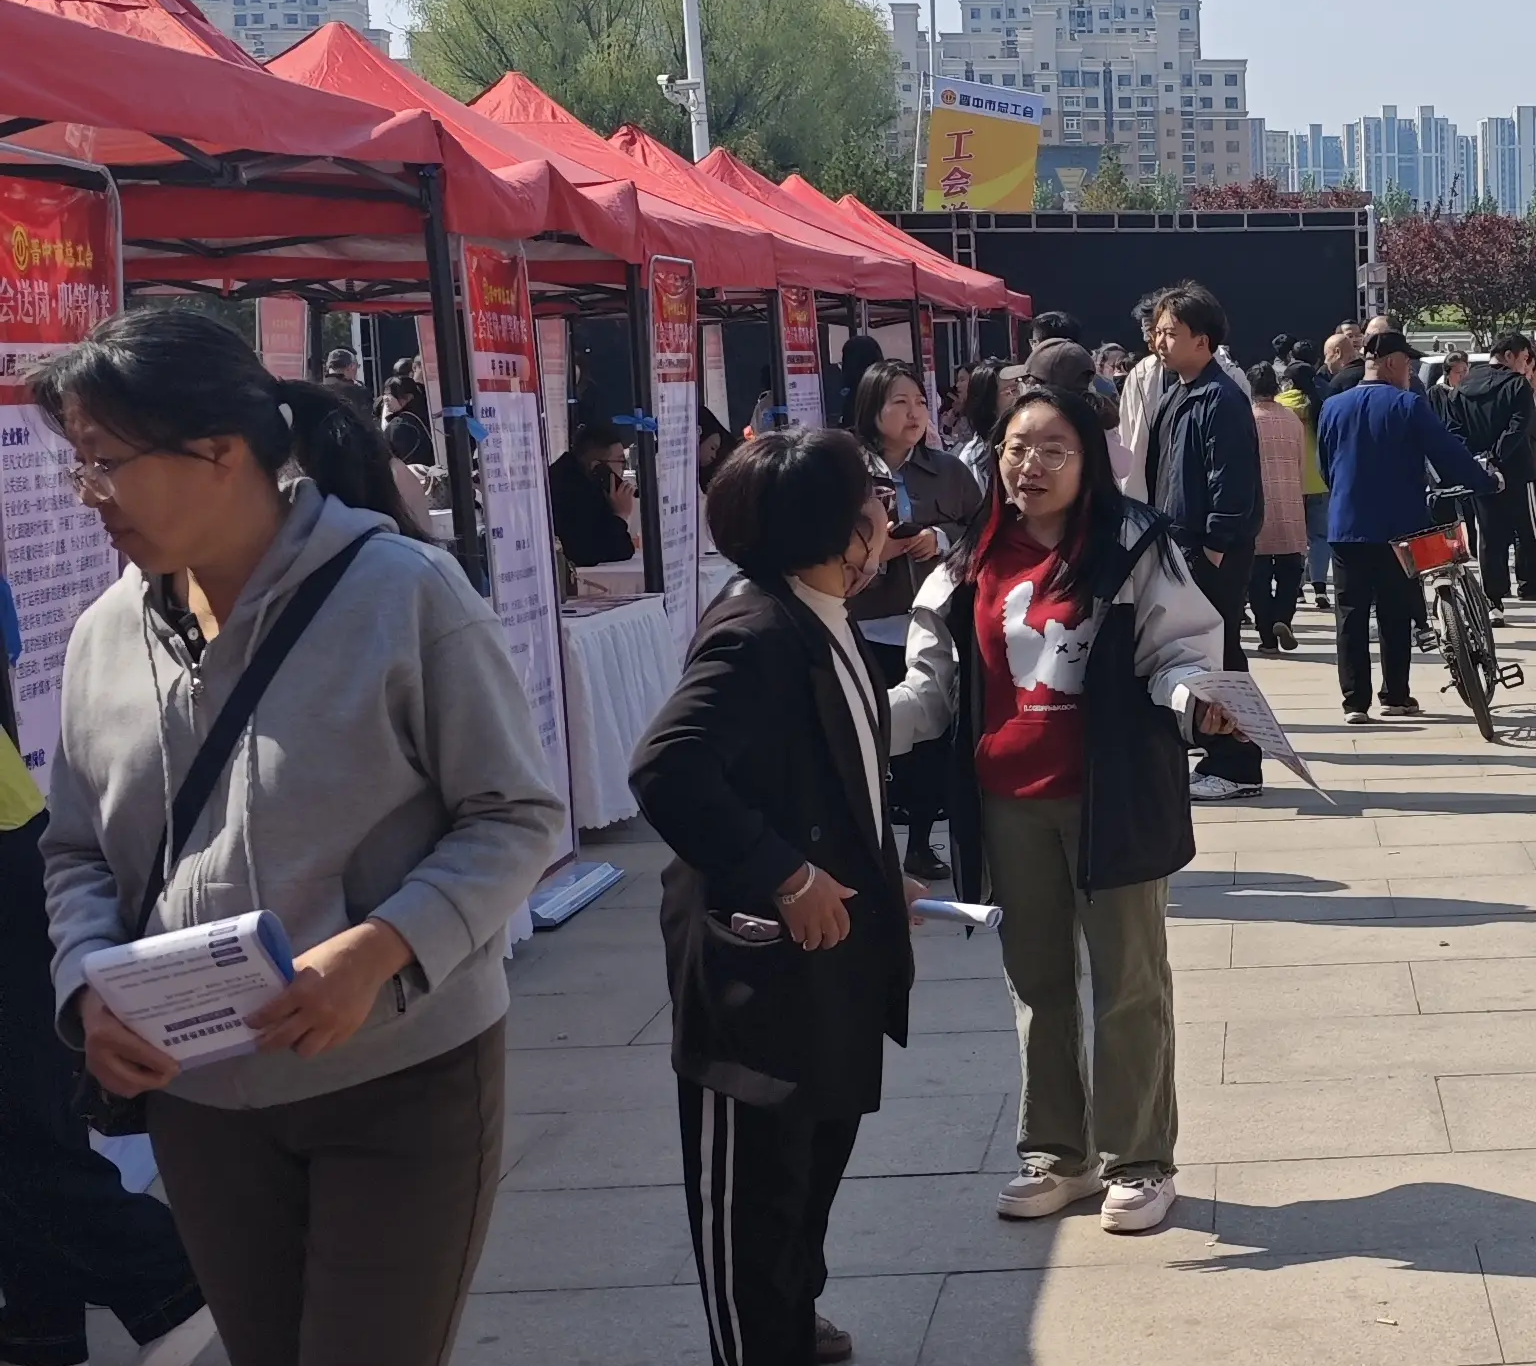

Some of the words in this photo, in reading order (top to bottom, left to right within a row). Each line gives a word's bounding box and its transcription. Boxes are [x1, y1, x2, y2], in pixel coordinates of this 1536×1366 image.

[959, 94, 1034, 118] 晋中市总工会
[30, 238, 94, 270] 晋中市总工会
